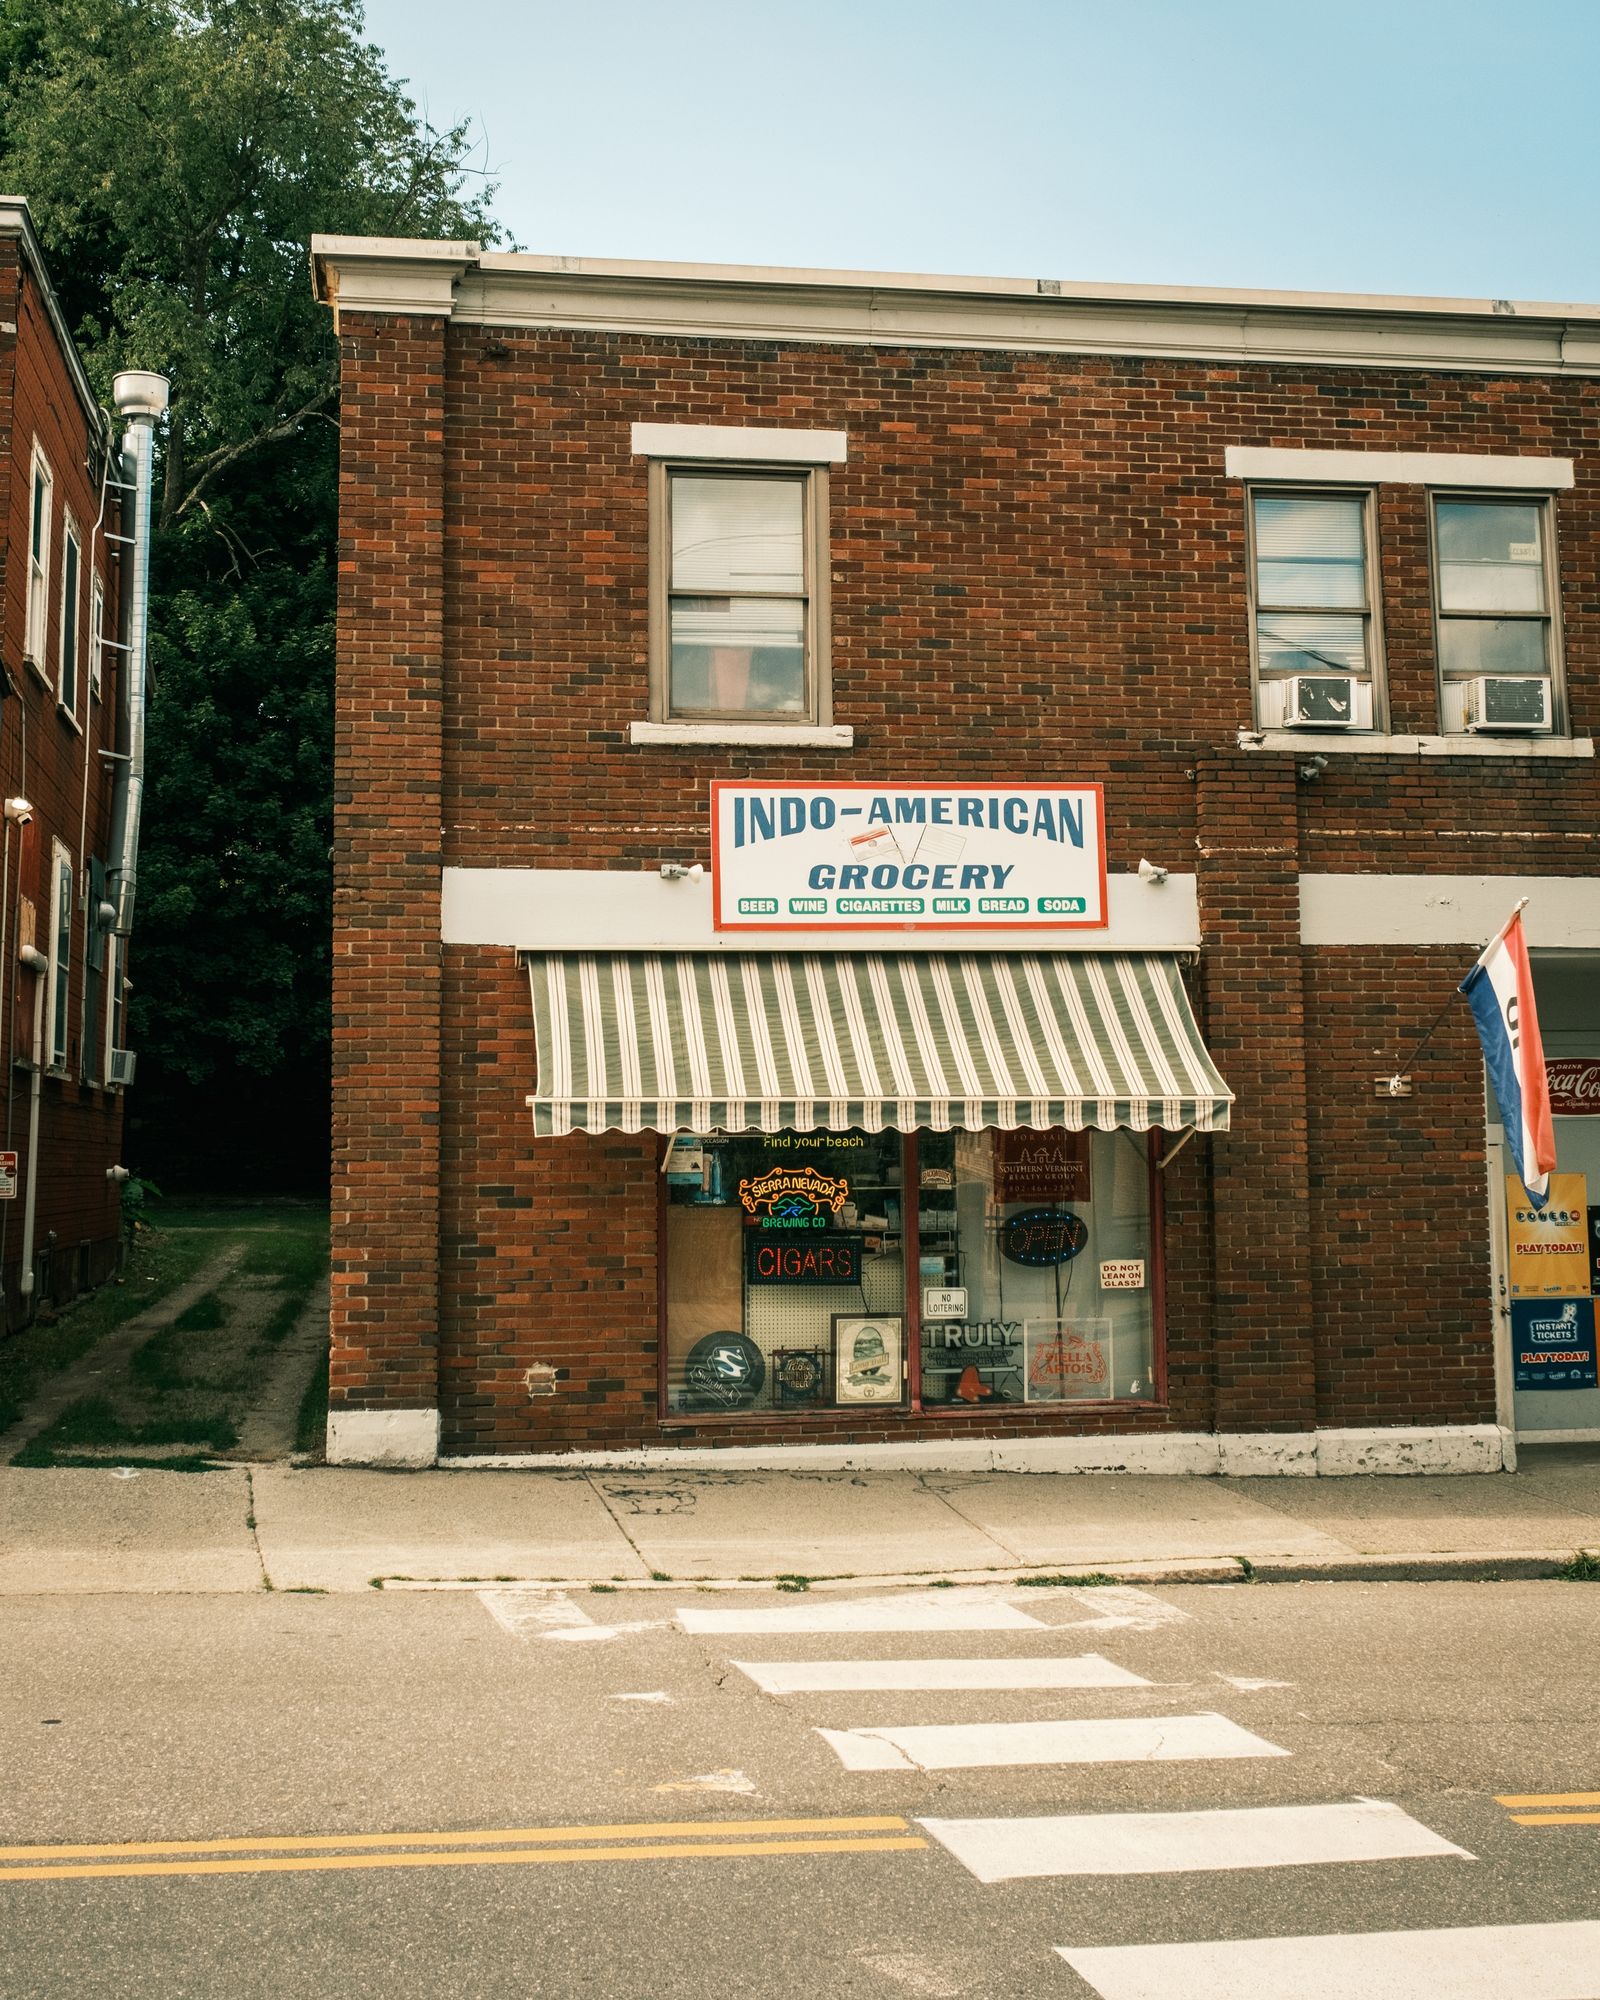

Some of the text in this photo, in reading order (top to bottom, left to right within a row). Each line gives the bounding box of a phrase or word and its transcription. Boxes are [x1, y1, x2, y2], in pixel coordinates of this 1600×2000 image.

[733, 796, 1084, 849] INDO-AMERICAN
[808, 864, 1015, 890] GROCERY
[740, 900, 1080, 912] BEER WINE CIGARETTES MILK BREAD SODA
[764, 1135, 864, 1149] Find your beach
[999, 1164, 1084, 1173] SOUTHERN VERMONT
[1009, 1173, 1041, 1181] REALTY
[752, 1177, 836, 1198] SIERRA NEVADA
[762, 1217, 810, 1228] BREWING
[812, 1217, 826, 1228] CO
[1009, 1223, 1081, 1252] OPEN
[1516, 1243, 1584, 1254] PLAY TODAY!
[757, 1247, 852, 1277] CIGARS
[941, 1294, 952, 1302] NO
[929, 1303, 964, 1312] LOITERING
[1536, 1323, 1572, 1331] INSTANT
[922, 1322, 1017, 1348] TRULY
[1536, 1331, 1572, 1339] TICKETS
[1046, 1352, 1092, 1362] STELLA
[1521, 1351, 1590, 1363] PLAY TODAY!
[1045, 1364, 1093, 1374] ARTOIS
